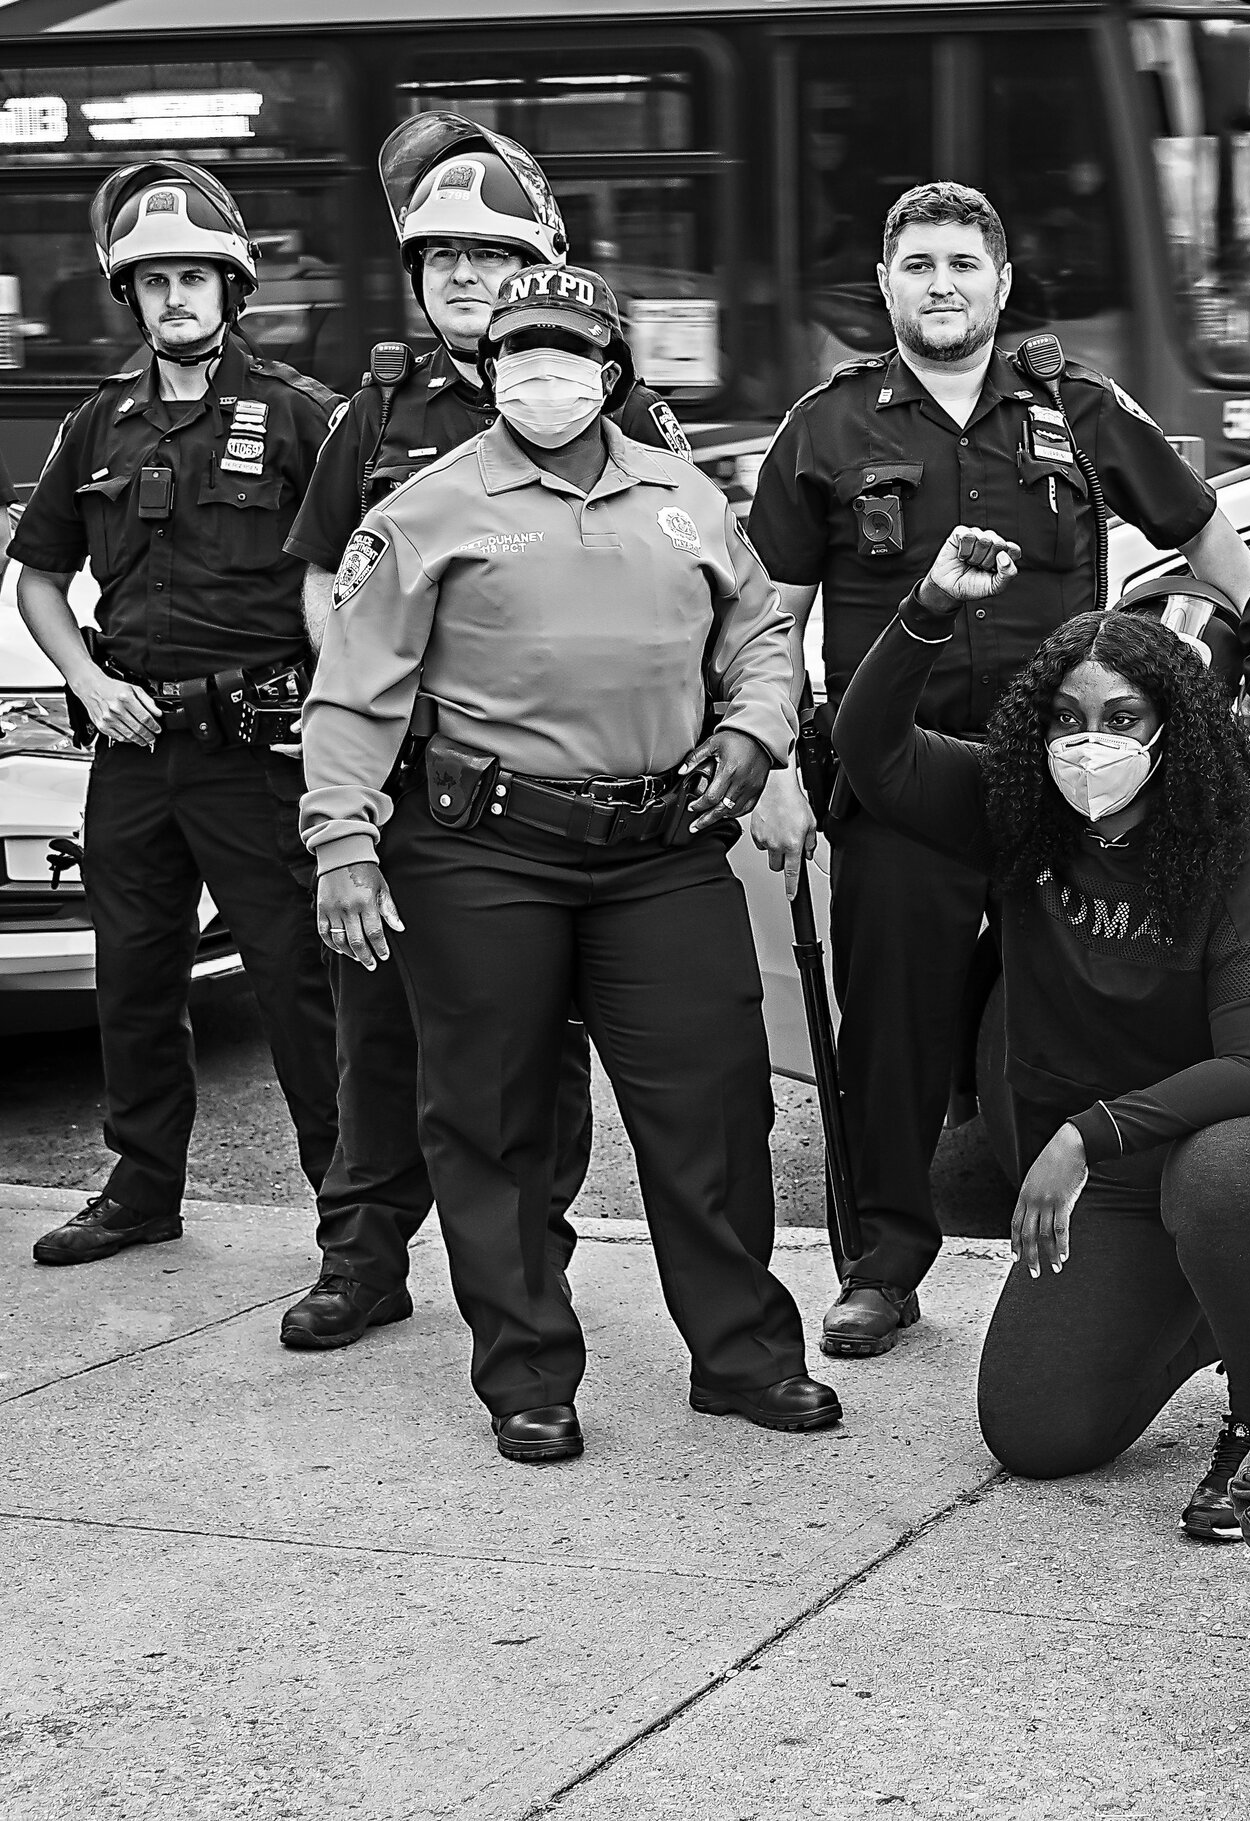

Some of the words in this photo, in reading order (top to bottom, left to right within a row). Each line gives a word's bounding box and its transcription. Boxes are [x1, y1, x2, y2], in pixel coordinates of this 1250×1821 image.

[508, 270, 594, 307] NYPD
[488, 531, 545, 546] DUHANEY
[502, 543, 527, 553] PCT
[355, 564, 372, 585] YORK
